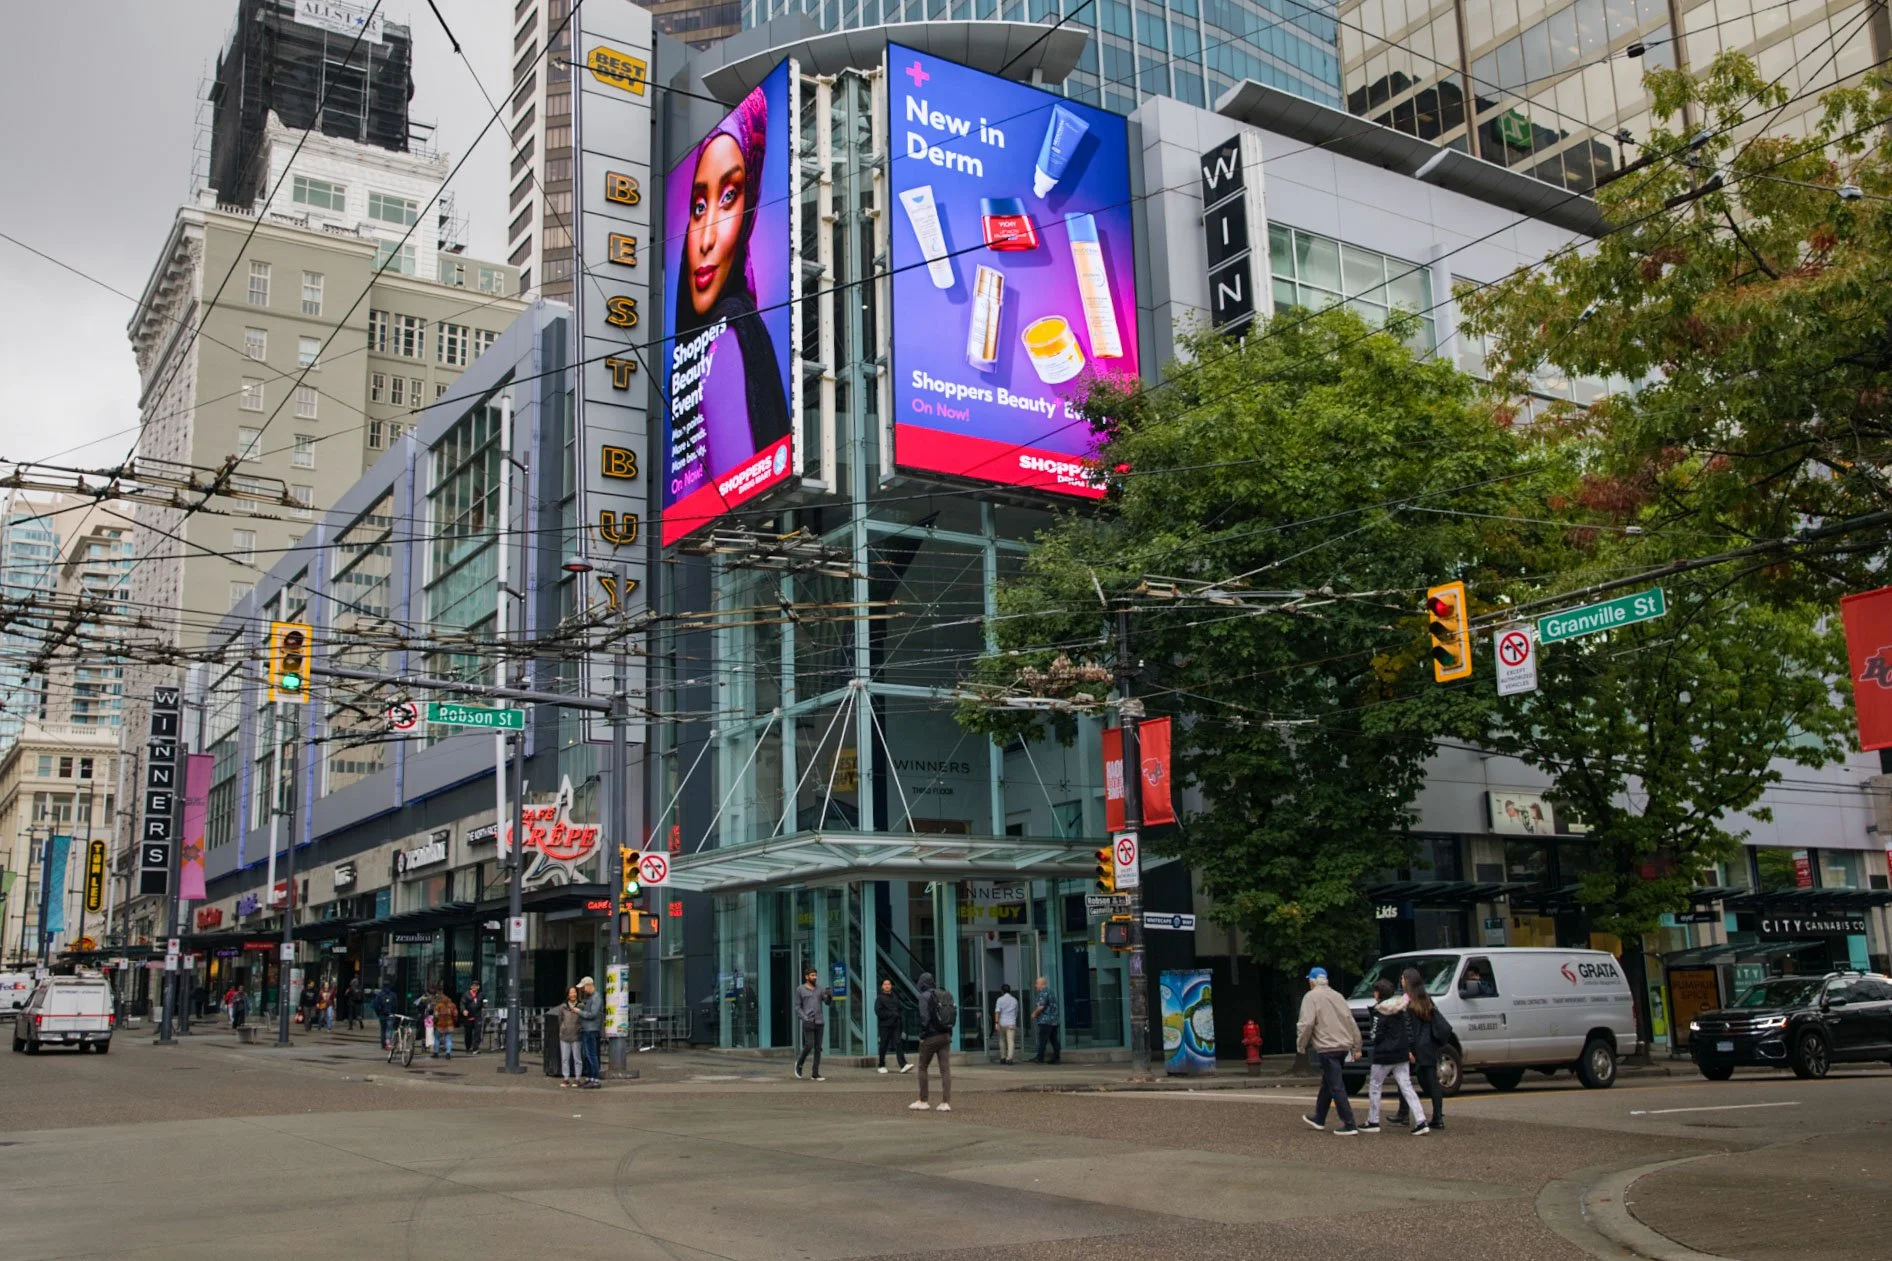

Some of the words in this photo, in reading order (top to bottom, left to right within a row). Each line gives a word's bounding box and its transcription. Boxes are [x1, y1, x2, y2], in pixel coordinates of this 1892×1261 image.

[596, 52, 644, 77] BEST
[906, 95, 971, 137] New
[980, 117, 1005, 148] in
[907, 131, 983, 177] Derm
[1203, 148, 1245, 352] WIN
[605, 170, 641, 391] BEST
[673, 316, 726, 369] Shoppers
[672, 353, 713, 395] Beauty
[912, 370, 993, 402] Shoppers
[997, 387, 1056, 418] Beauty
[672, 381, 704, 420] Event
[912, 397, 934, 415] On
[936, 403, 970, 422] Now!
[671, 479, 683, 494] On
[684, 464, 703, 487] Now!
[719, 455, 772, 496] SHOPPERS
[1547, 606, 1626, 637] Granville
[1634, 596, 1656, 616] St
[1506, 667, 1526, 676] EXCEPT
[440, 707, 492, 724] Robson
[498, 712, 512, 726] St
[149, 692, 177, 863] WINNERS
[895, 760, 970, 774] WINNERS
[961, 886, 1025, 899] INNERS
[1762, 920, 1802, 932] CITY
[1805, 920, 1850, 931] CANNABIS
[1852, 920, 1865, 930] CO
[1578, 963, 1619, 978] GRATA
